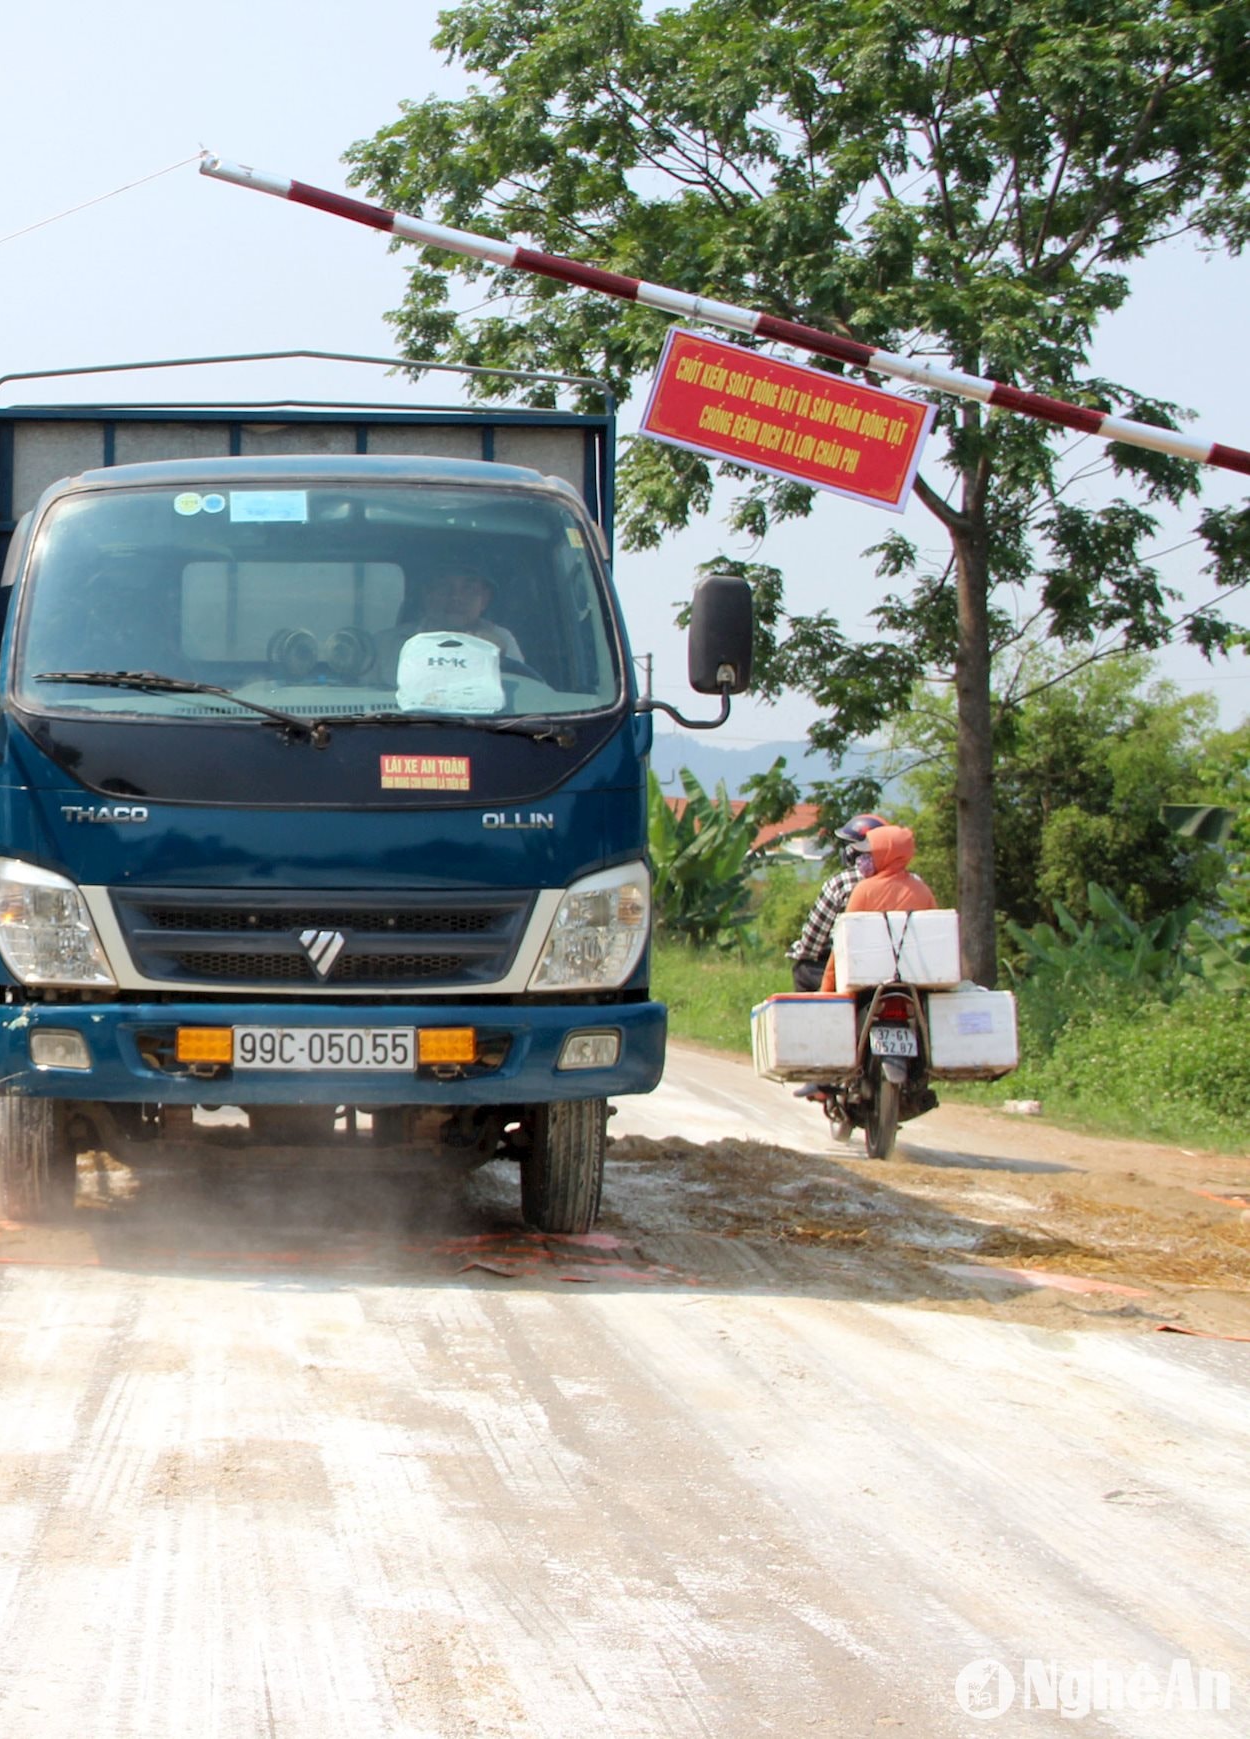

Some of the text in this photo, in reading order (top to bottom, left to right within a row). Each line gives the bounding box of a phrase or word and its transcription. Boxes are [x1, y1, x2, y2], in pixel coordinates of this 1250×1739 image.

[676, 353, 704, 384] CHỐT
[726, 370, 754, 399] SOÁT
[750, 376, 780, 408] ĐỘNG
[778, 384, 799, 416] VẬT
[796, 389, 812, 418] VÀ
[810, 389, 834, 424] SẢN
[859, 409, 889, 442] ĐỘNG
[887, 416, 908, 449] VẬT
[699, 401, 861, 474] CHỐNG BỆNH DỊCH TẢ LỢN CHÂU PHI
[385, 756, 466, 774] LÁI XE AN TOÀN
[60, 806, 148, 823] THACO
[482, 812, 554, 829] OLLIN
[240, 1032, 408, 1064] 99C-050.55
